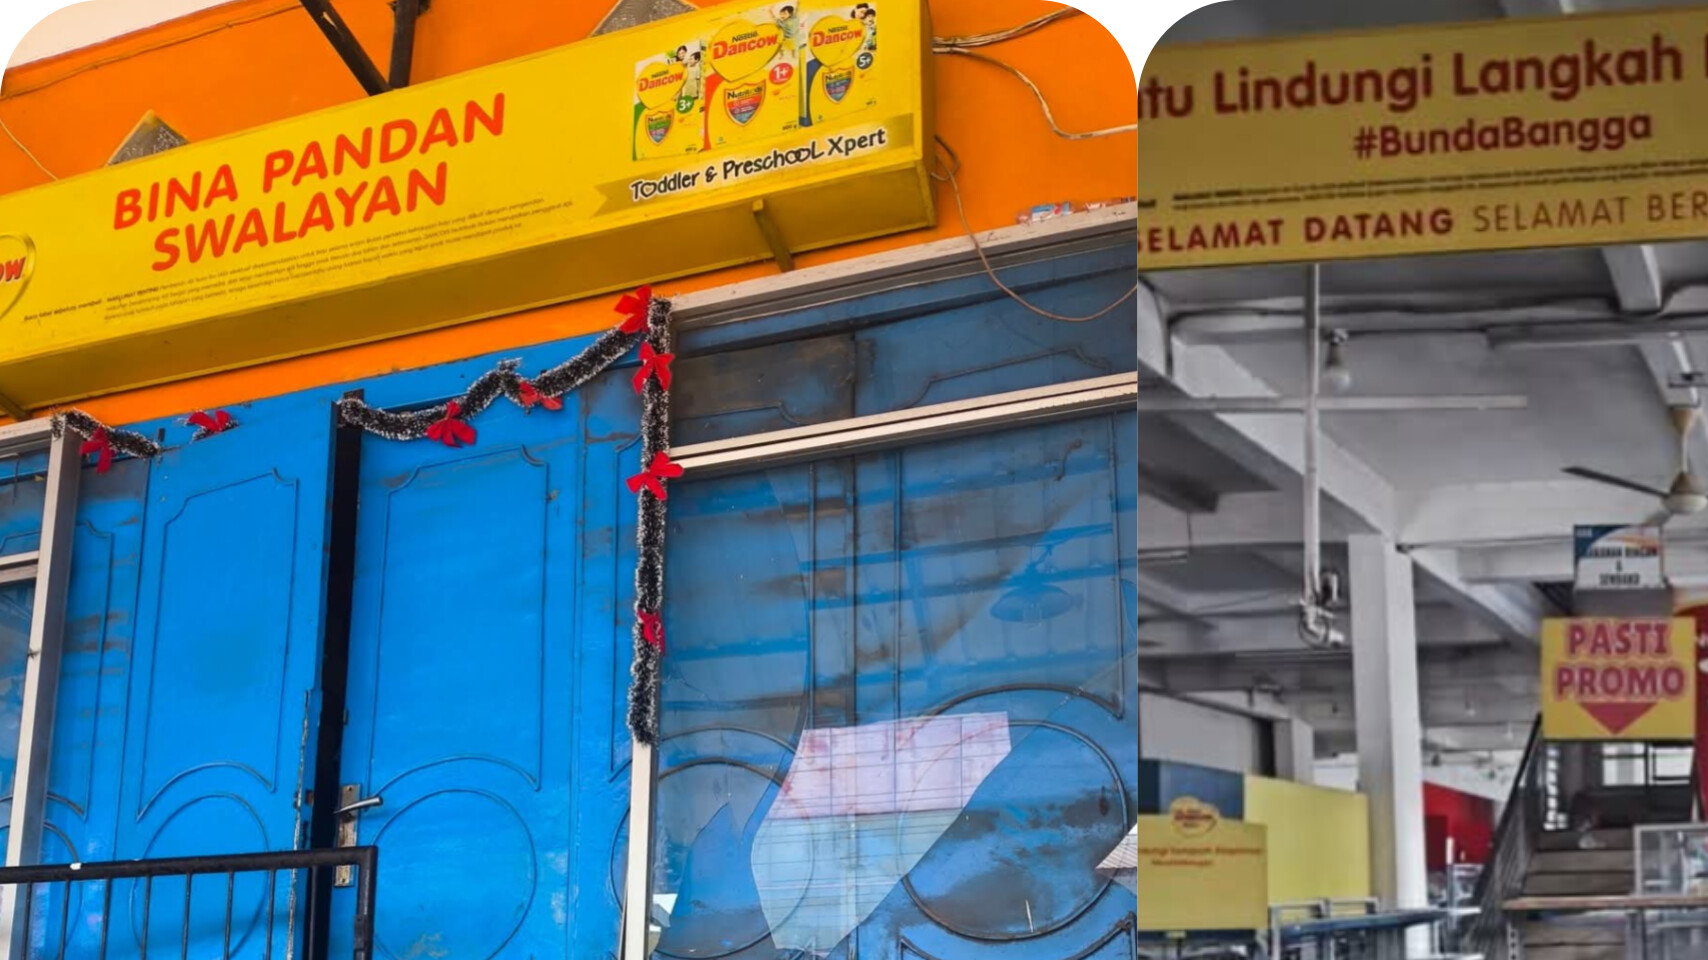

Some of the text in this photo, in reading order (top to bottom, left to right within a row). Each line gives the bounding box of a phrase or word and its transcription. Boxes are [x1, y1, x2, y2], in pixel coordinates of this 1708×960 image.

[1214, 53, 1432, 113] Lindungi
[1453, 33, 1682, 101] Langkah
[113, 92, 506, 230] BINA PANDAN
[631, 171, 700, 200] Toddler
[705, 166, 718, 183] &
[828, 128, 887, 156] Xpert
[1354, 113, 1652, 159] #BundaBangga
[151, 161, 448, 272] SWALAYAN
[1138, 219, 1284, 254] ELAMAT
[1304, 208, 1454, 243] DATANG
[1473, 196, 1629, 234] SELAMAT
[1569, 622, 1670, 656] PASTI
[1557, 667, 1685, 697] PROMO
